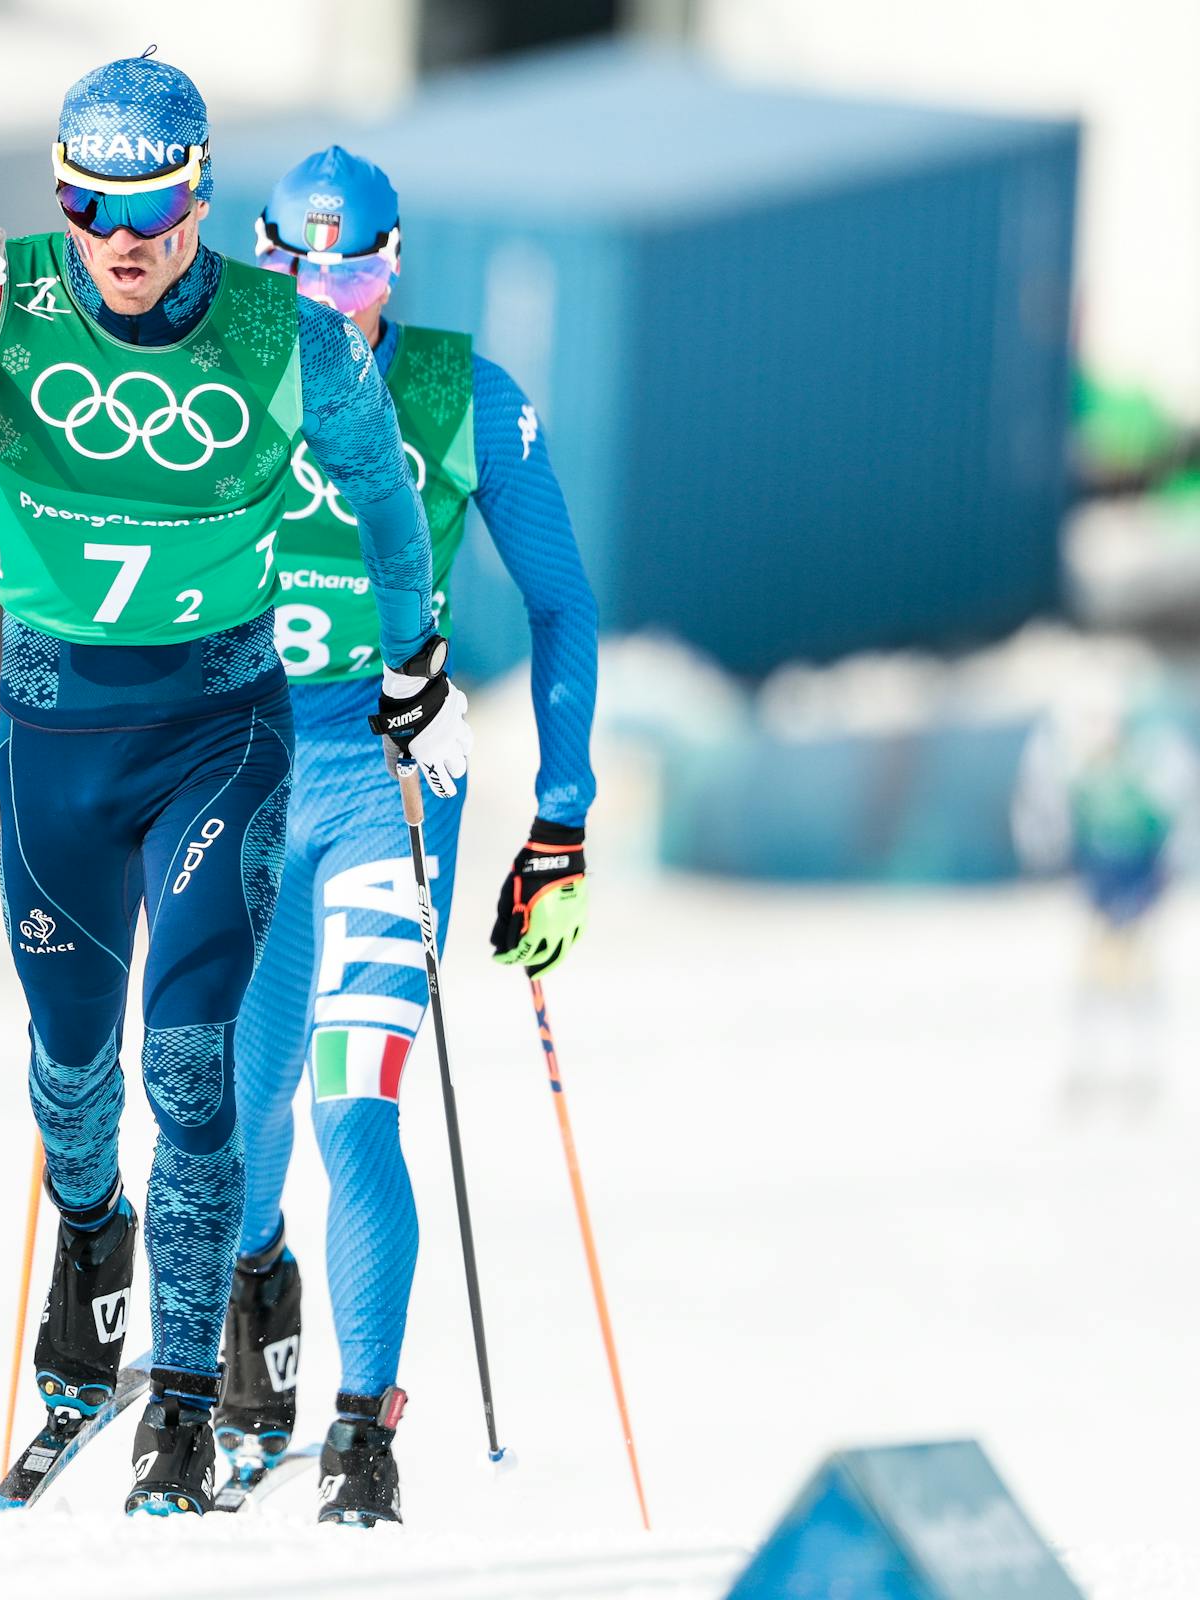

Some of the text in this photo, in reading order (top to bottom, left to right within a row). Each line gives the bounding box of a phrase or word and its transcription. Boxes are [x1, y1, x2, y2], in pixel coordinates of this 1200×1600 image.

[83, 542, 152, 624] 7
[173, 589, 203, 624] 2
[274, 603, 332, 677] 8
[387, 704, 424, 729] SWIX
[172, 818, 225, 895] odlo
[19, 942, 76, 954] FRANCE
[314, 854, 441, 1035] ITA
[417, 884, 435, 961] SWIX
